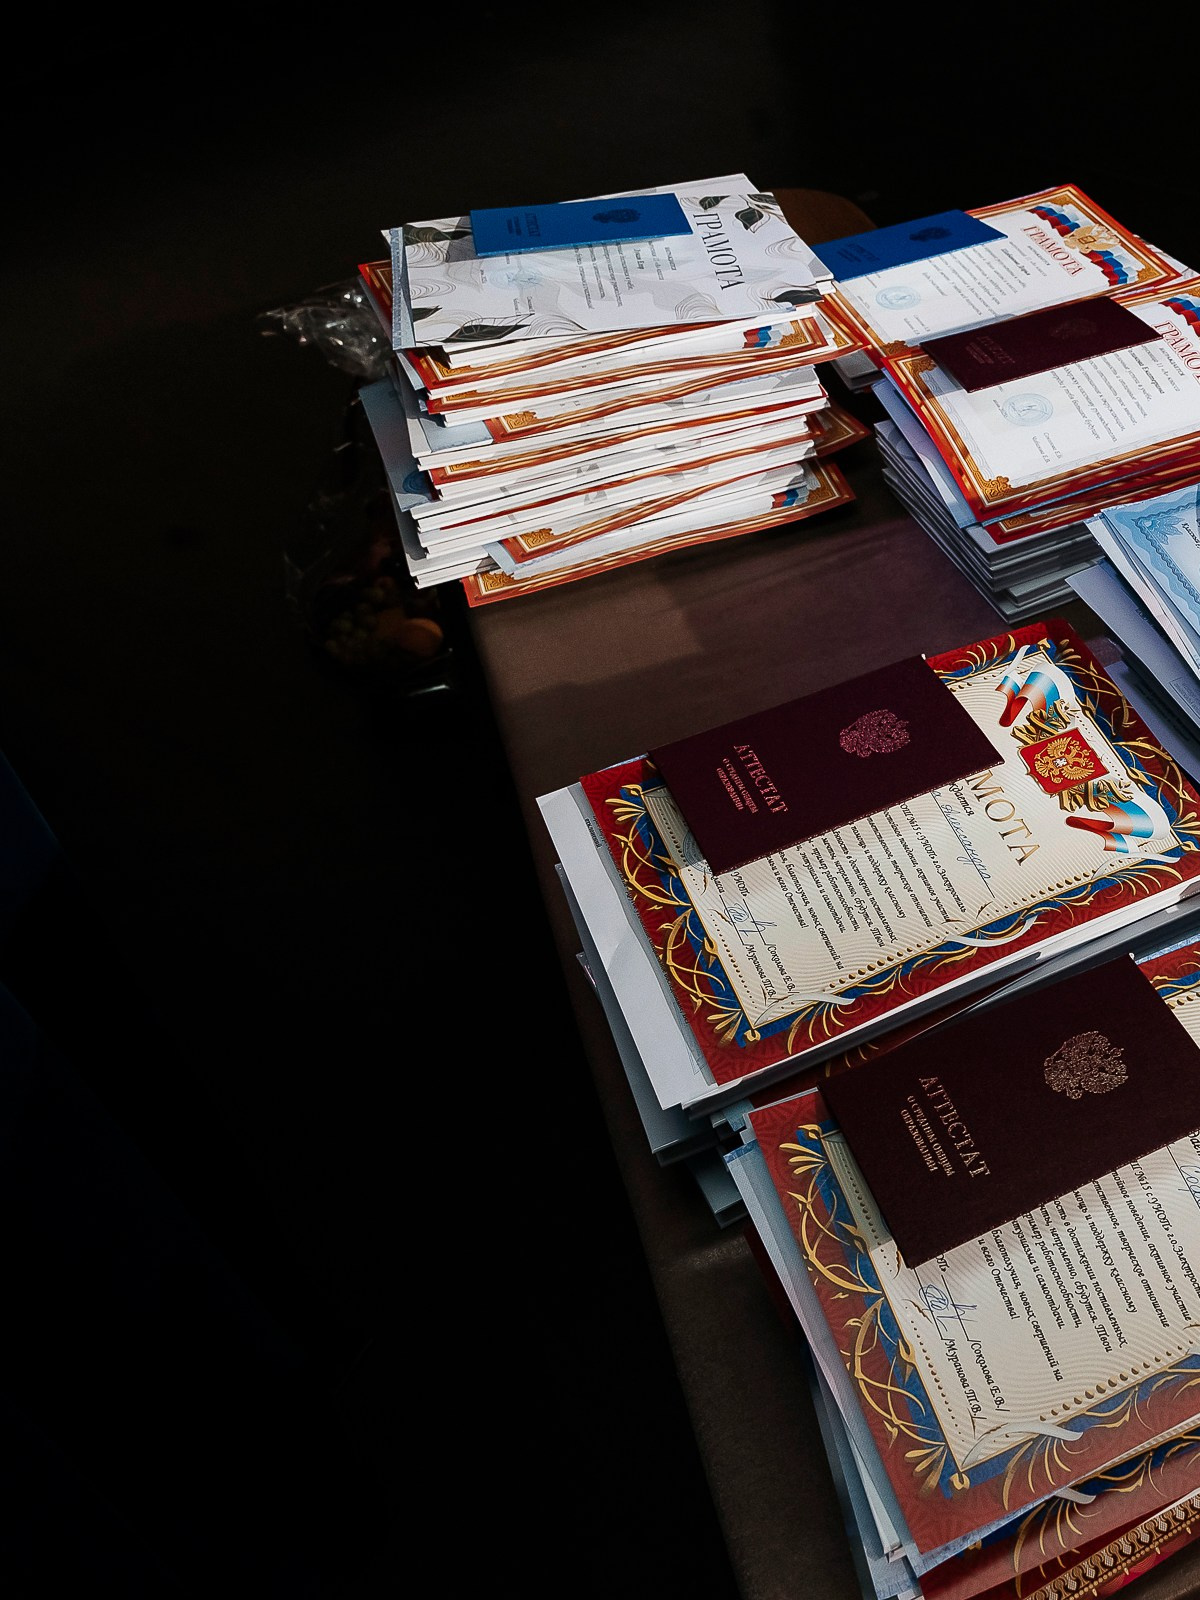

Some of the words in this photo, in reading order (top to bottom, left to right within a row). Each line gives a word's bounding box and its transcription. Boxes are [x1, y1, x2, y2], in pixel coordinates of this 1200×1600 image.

[692, 212, 745, 290] ГРАМОТА
[1022, 225, 1083, 276] ГРАМОТА
[733, 744, 789, 813] АТТЕСТАТ
[964, 769, 1040, 866] МОТА
[799, 851, 824, 889] энтузиазма
[821, 894, 847, 934] самоотдачи.
[810, 847, 829, 871] пример
[850, 825, 867, 849] помощь
[866, 854, 889, 887] поддержку
[883, 885, 907, 919] классному
[890, 859, 914, 893] творческое
[909, 893, 934, 928] отношение
[915, 867, 937, 897] активное
[775, 875, 789, 892] всего
[784, 891, 810, 929] Отечества!
[784, 863, 811, 907] благополучия,
[807, 906, 823, 930] новых
[817, 927, 841, 962] свершений
[835, 960, 845, 971] на
[848, 858, 873, 898] достижении
[868, 896, 899, 944] поставленных
[869, 927, 886, 948] Твои
[900, 1108, 939, 1172] ОБРАЗОВАНИИ
[911, 1102, 938, 1144] СРЕДНЕМ
[932, 1142, 956, 1177] ОБЩЕМ
[918, 1077, 991, 1178] АТТЕСТАТ
[1133, 1168, 1153, 1191] №15
[980, 1245, 996, 1268] всего
[990, 1268, 1021, 1320] Отечества!
[1034, 1240, 1083, 1329] работоспособности,
[1049, 1227, 1078, 1280] непременно,
[1073, 1280, 1098, 1324] сбудутся.
[1093, 1323, 1113, 1353] Твои
[1066, 1226, 1097, 1281] достижении
[1091, 1280, 1128, 1349] поставленных
[1088, 1221, 1115, 1267] поддержку
[1109, 1266, 1138, 1314] классному
[1116, 1229, 1145, 1278] творческое
[1140, 1278, 1170, 1328] отношение
[1125, 1199, 1151, 1242] поведение,
[1147, 1242, 1173, 1284] активное
[1164, 1284, 1192, 1322] участие
[990, 1228, 1022, 1290] благополучия,
[1018, 1290, 1037, 1322] новых
[1030, 1319, 1060, 1369] свершений
[1052, 1368, 1064, 1382] на
[1035, 1273, 1066, 1330] самоотдачи.
